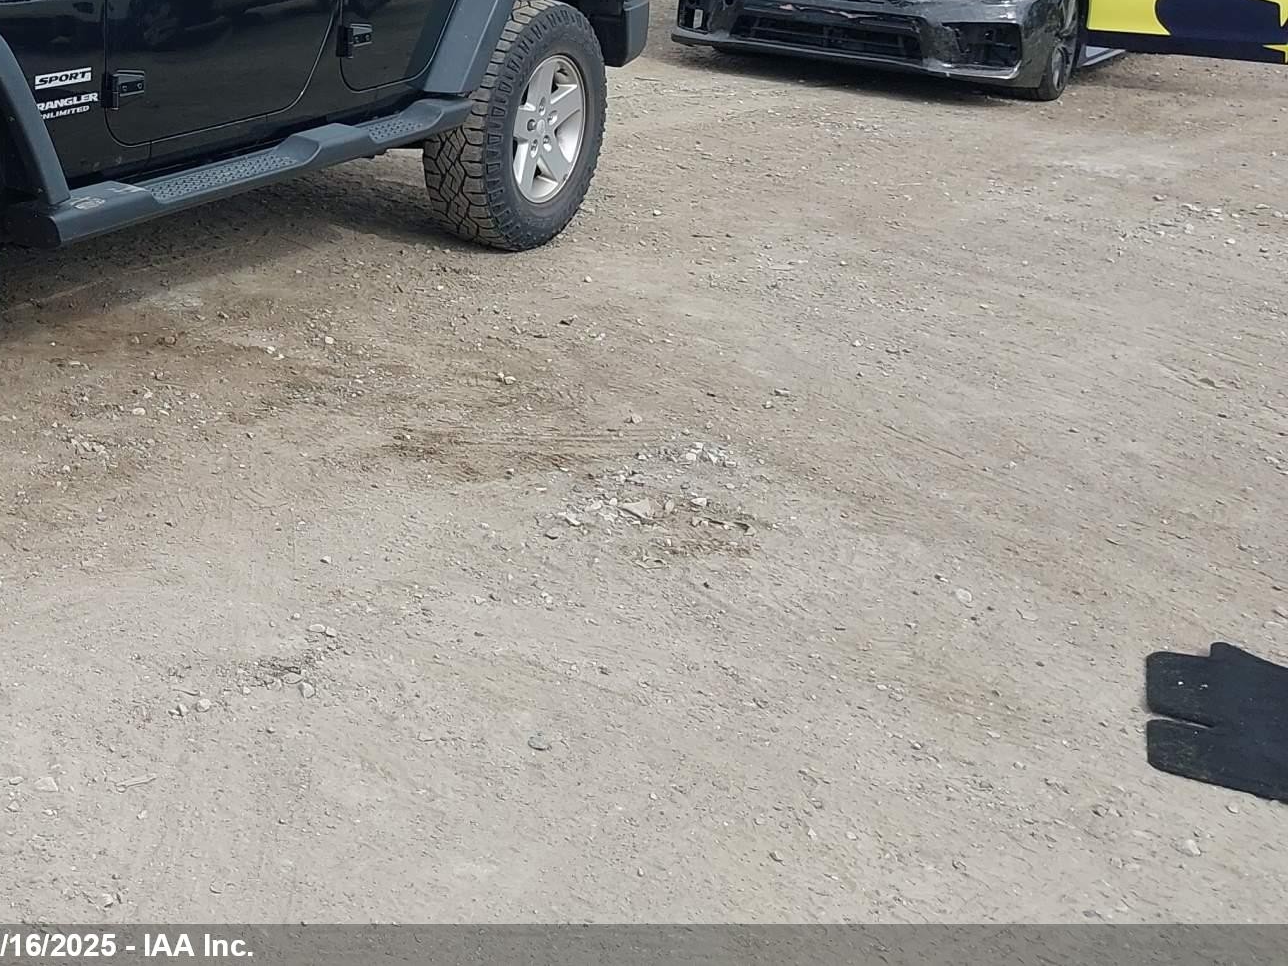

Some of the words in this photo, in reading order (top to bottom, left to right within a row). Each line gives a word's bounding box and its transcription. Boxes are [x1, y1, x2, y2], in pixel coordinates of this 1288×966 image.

[38, 70, 88, 85] SPORT
[36, 92, 98, 110] RANGLER
[40, 105, 89, 120] NLIMITED
